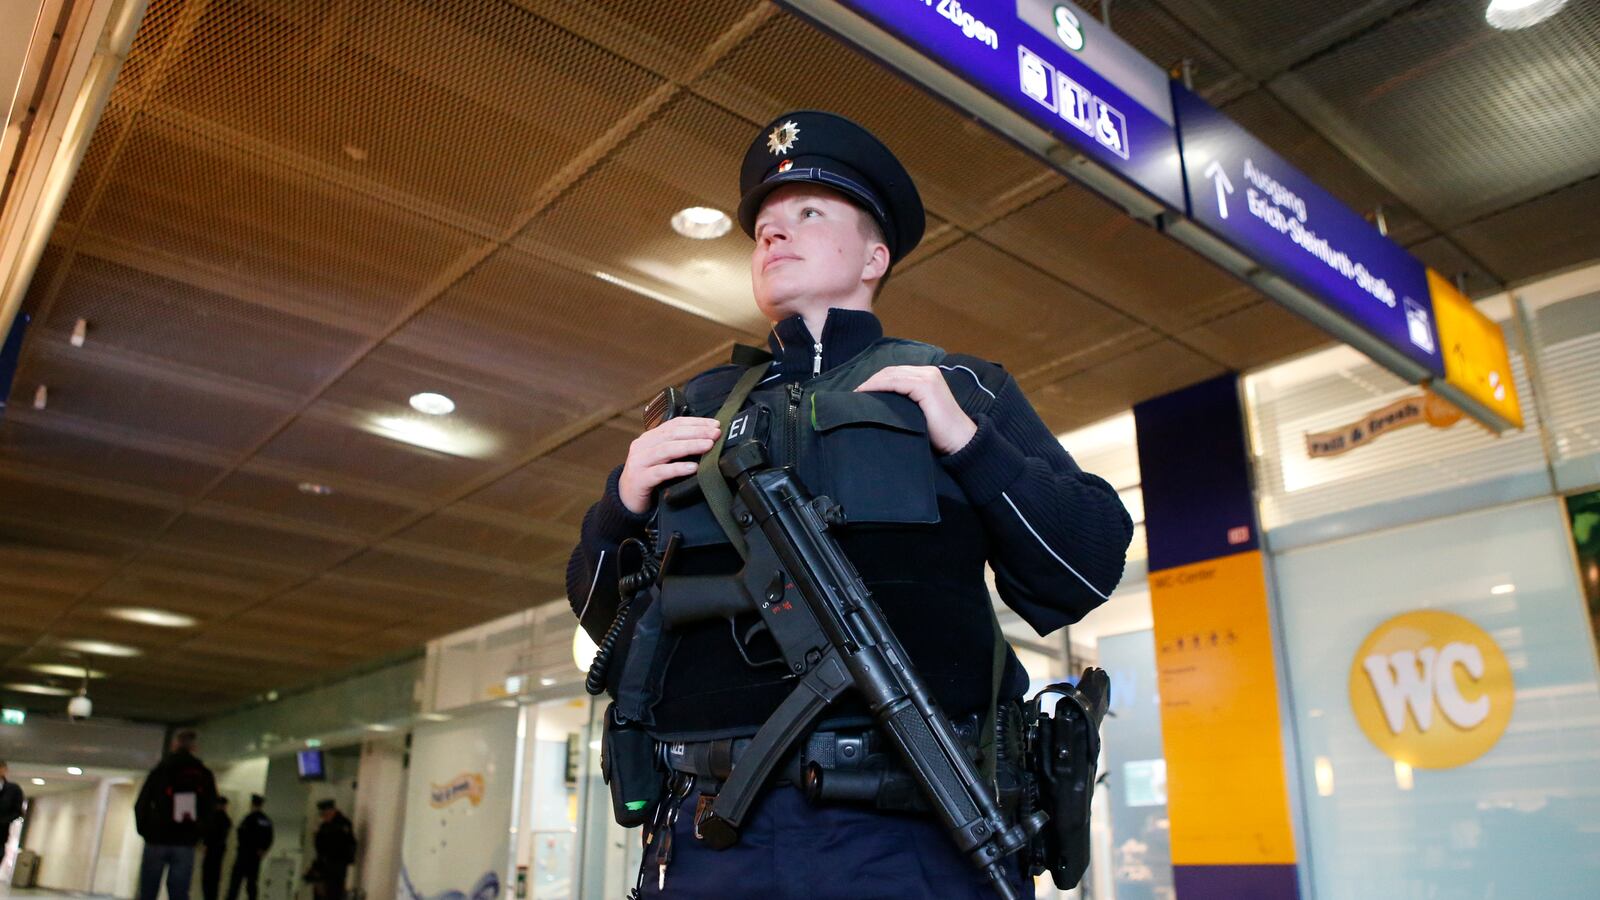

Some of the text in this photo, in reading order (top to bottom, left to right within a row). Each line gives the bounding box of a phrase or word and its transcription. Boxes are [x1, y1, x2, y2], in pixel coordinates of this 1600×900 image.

[1054, 4, 1084, 51] S
[727, 414, 749, 440] EI
[1362, 641, 1491, 735] WC
